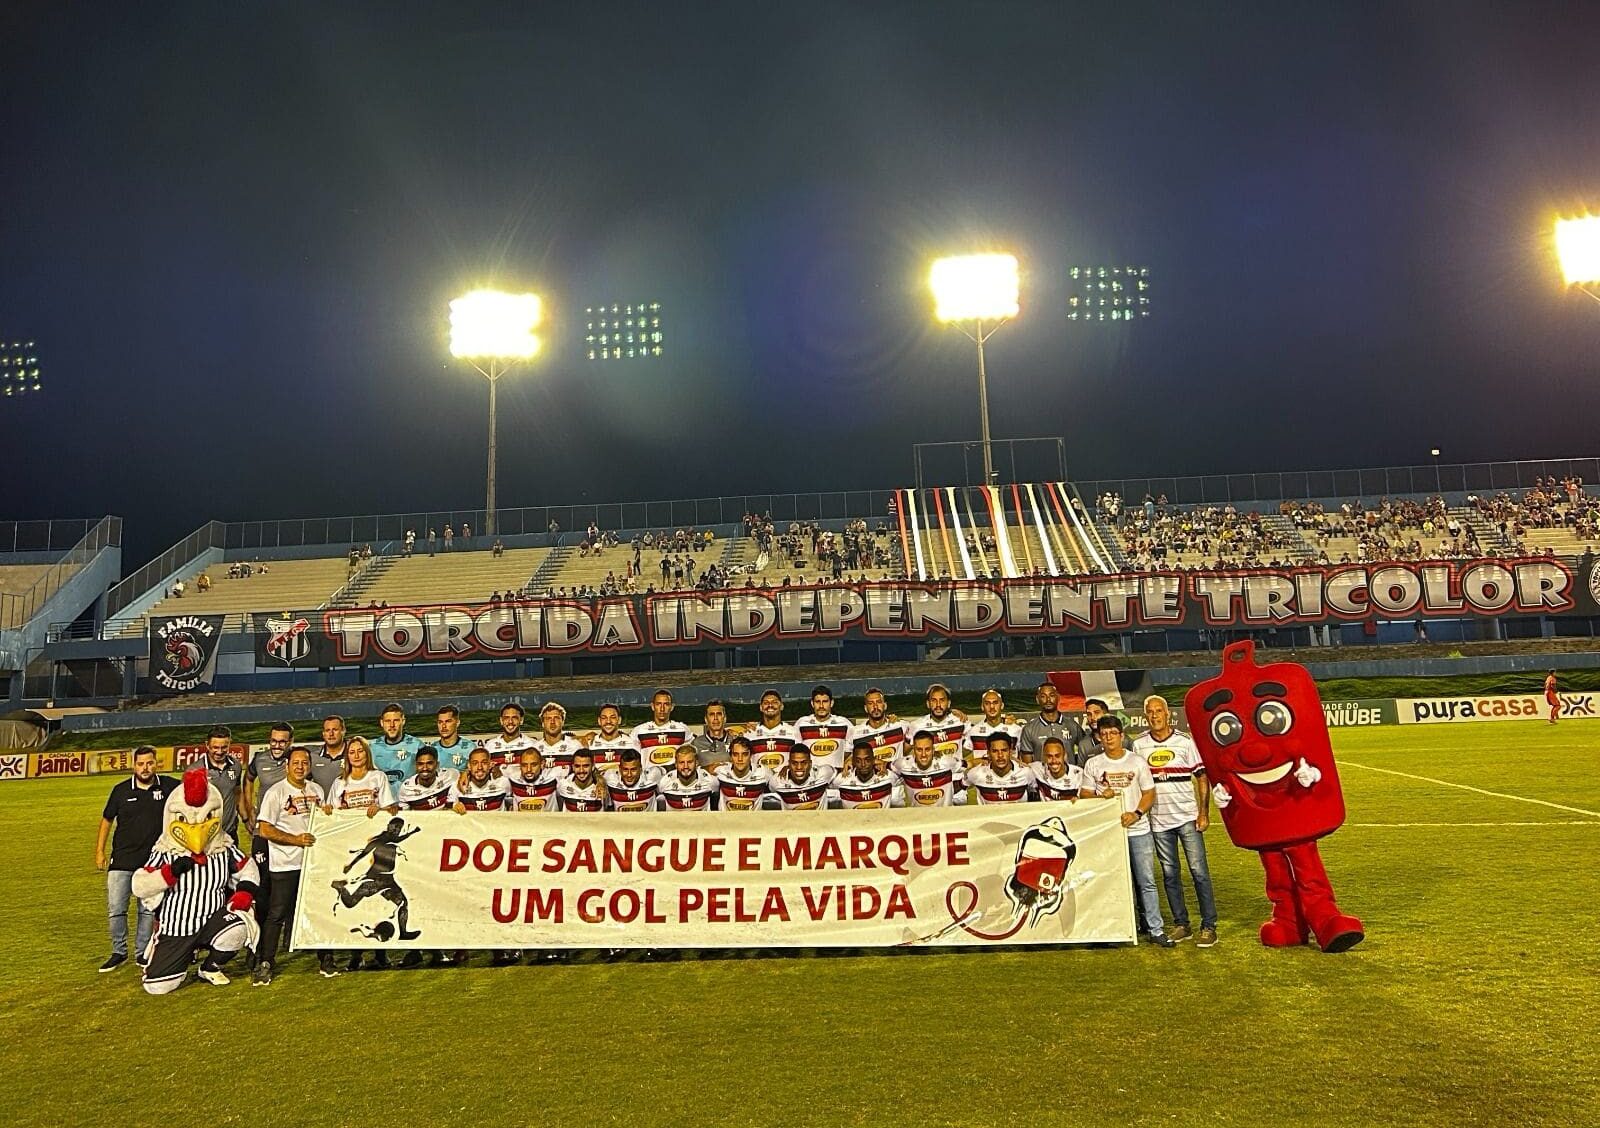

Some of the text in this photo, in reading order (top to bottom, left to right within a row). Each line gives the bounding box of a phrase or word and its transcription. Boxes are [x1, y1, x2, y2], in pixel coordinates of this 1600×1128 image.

[328, 602, 640, 658] TORCIDA
[650, 576, 1182, 642] INDEPENDENTE
[1194, 561, 1571, 620] TRICOLOR
[157, 615, 214, 639] FAMÍLIA
[1324, 708, 1381, 726] NIUBE
[1346, 702, 1359, 710] DO
[35, 752, 86, 776] jamel
[439, 832, 970, 875] DOE SANGUE E MARQUE
[492, 884, 917, 924] UM GOL PELA VIDA
